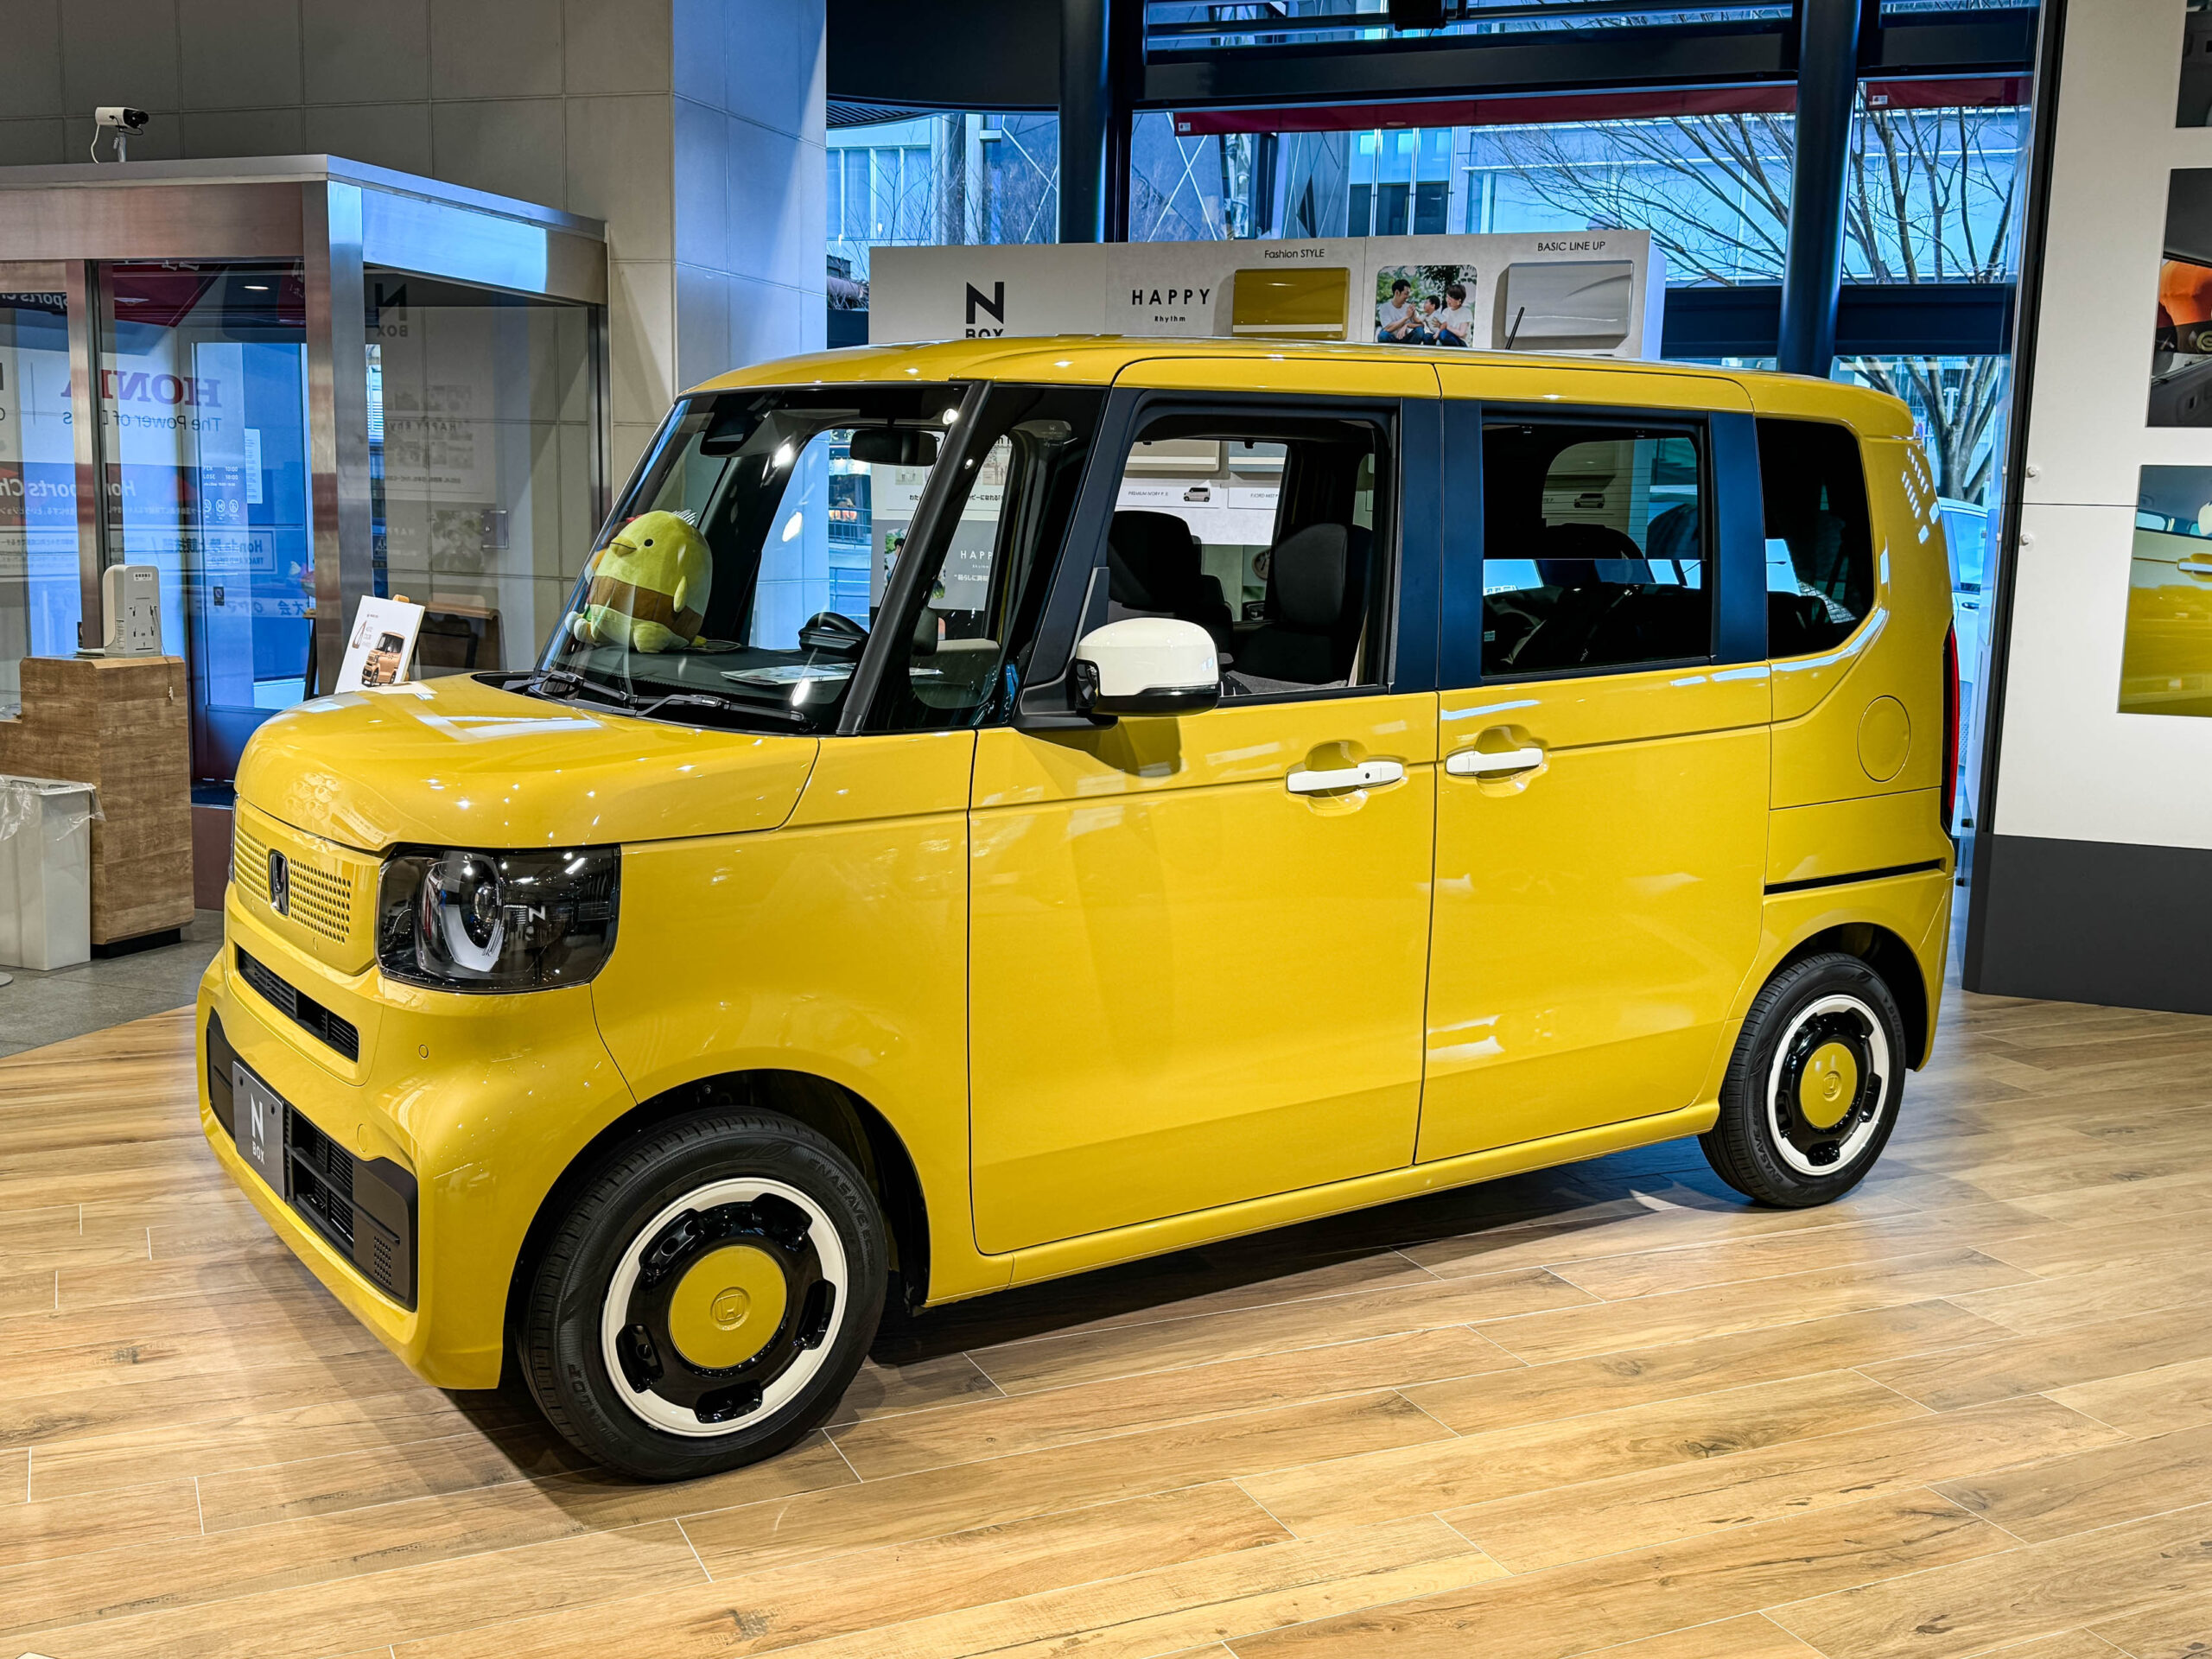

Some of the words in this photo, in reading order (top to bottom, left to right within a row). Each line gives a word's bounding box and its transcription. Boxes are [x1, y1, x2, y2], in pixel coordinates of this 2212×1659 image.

[1264, 249, 1299, 259] Fashion
[1300, 248, 1326, 258] STYLE
[1537, 242, 1567, 252] BASIC
[1569, 242, 1590, 251] LINE
[1592, 241, 1605, 251] UP
[966, 282, 1004, 325] N
[1132, 289, 1210, 305] HAPPY
[251, 1092, 264, 1147] N
[252, 1141, 265, 1165] BOX
